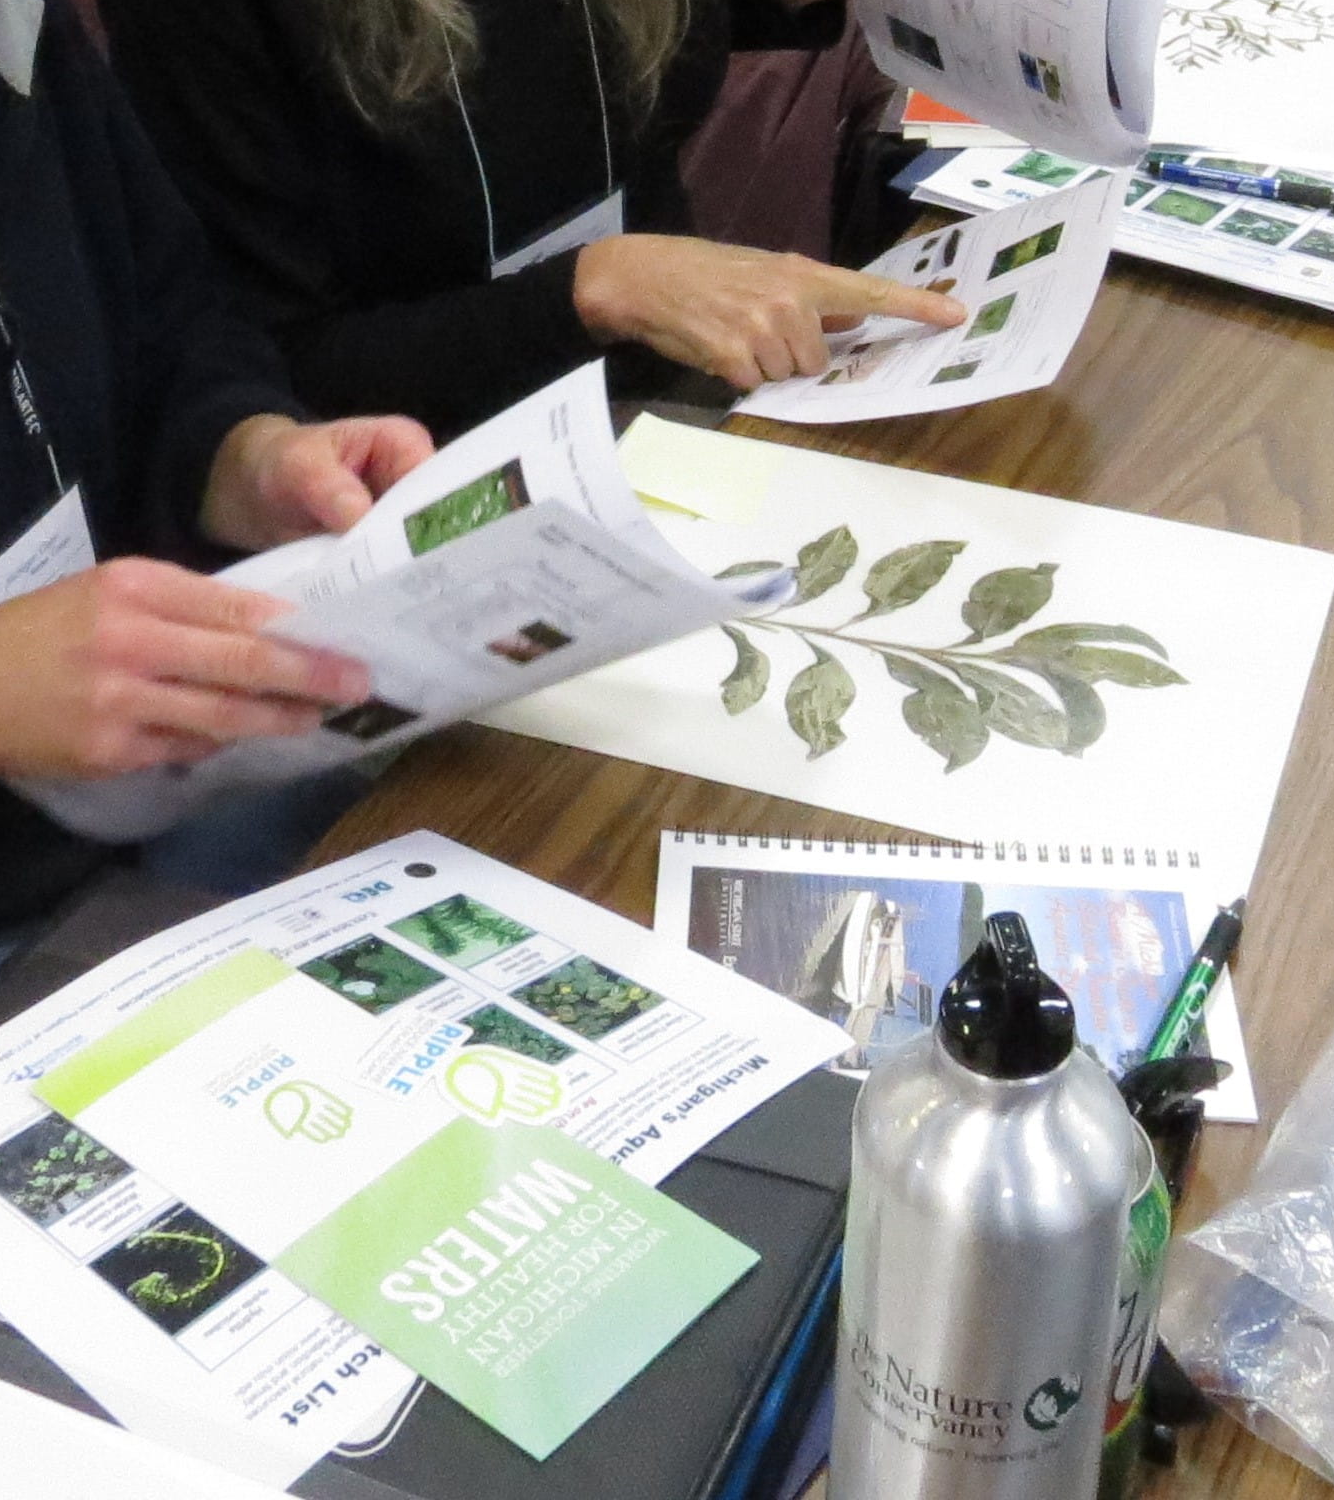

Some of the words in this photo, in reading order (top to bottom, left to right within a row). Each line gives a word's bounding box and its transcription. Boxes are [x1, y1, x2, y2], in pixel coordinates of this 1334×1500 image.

[338, 877, 394, 910] DEQ
[214, 1051, 296, 1110] RIPPLE
[383, 1019, 465, 1100] RIPPLE
[659, 1051, 770, 1127] Michigan's
[373, 1155, 594, 1328] WATERS
[560, 1189, 620, 1240] FOR
[604, 1207, 645, 1242] IN
[438, 1232, 567, 1346] HEALTHY
[580, 1225, 668, 1299] WORKING
[463, 1234, 612, 1366] MICHIGAN
[333, 1341, 385, 1386] tch
[488, 1295, 587, 1381] TOGETHER
[278, 1379, 336, 1430] List
[885, 1353, 1013, 1420] Nature
